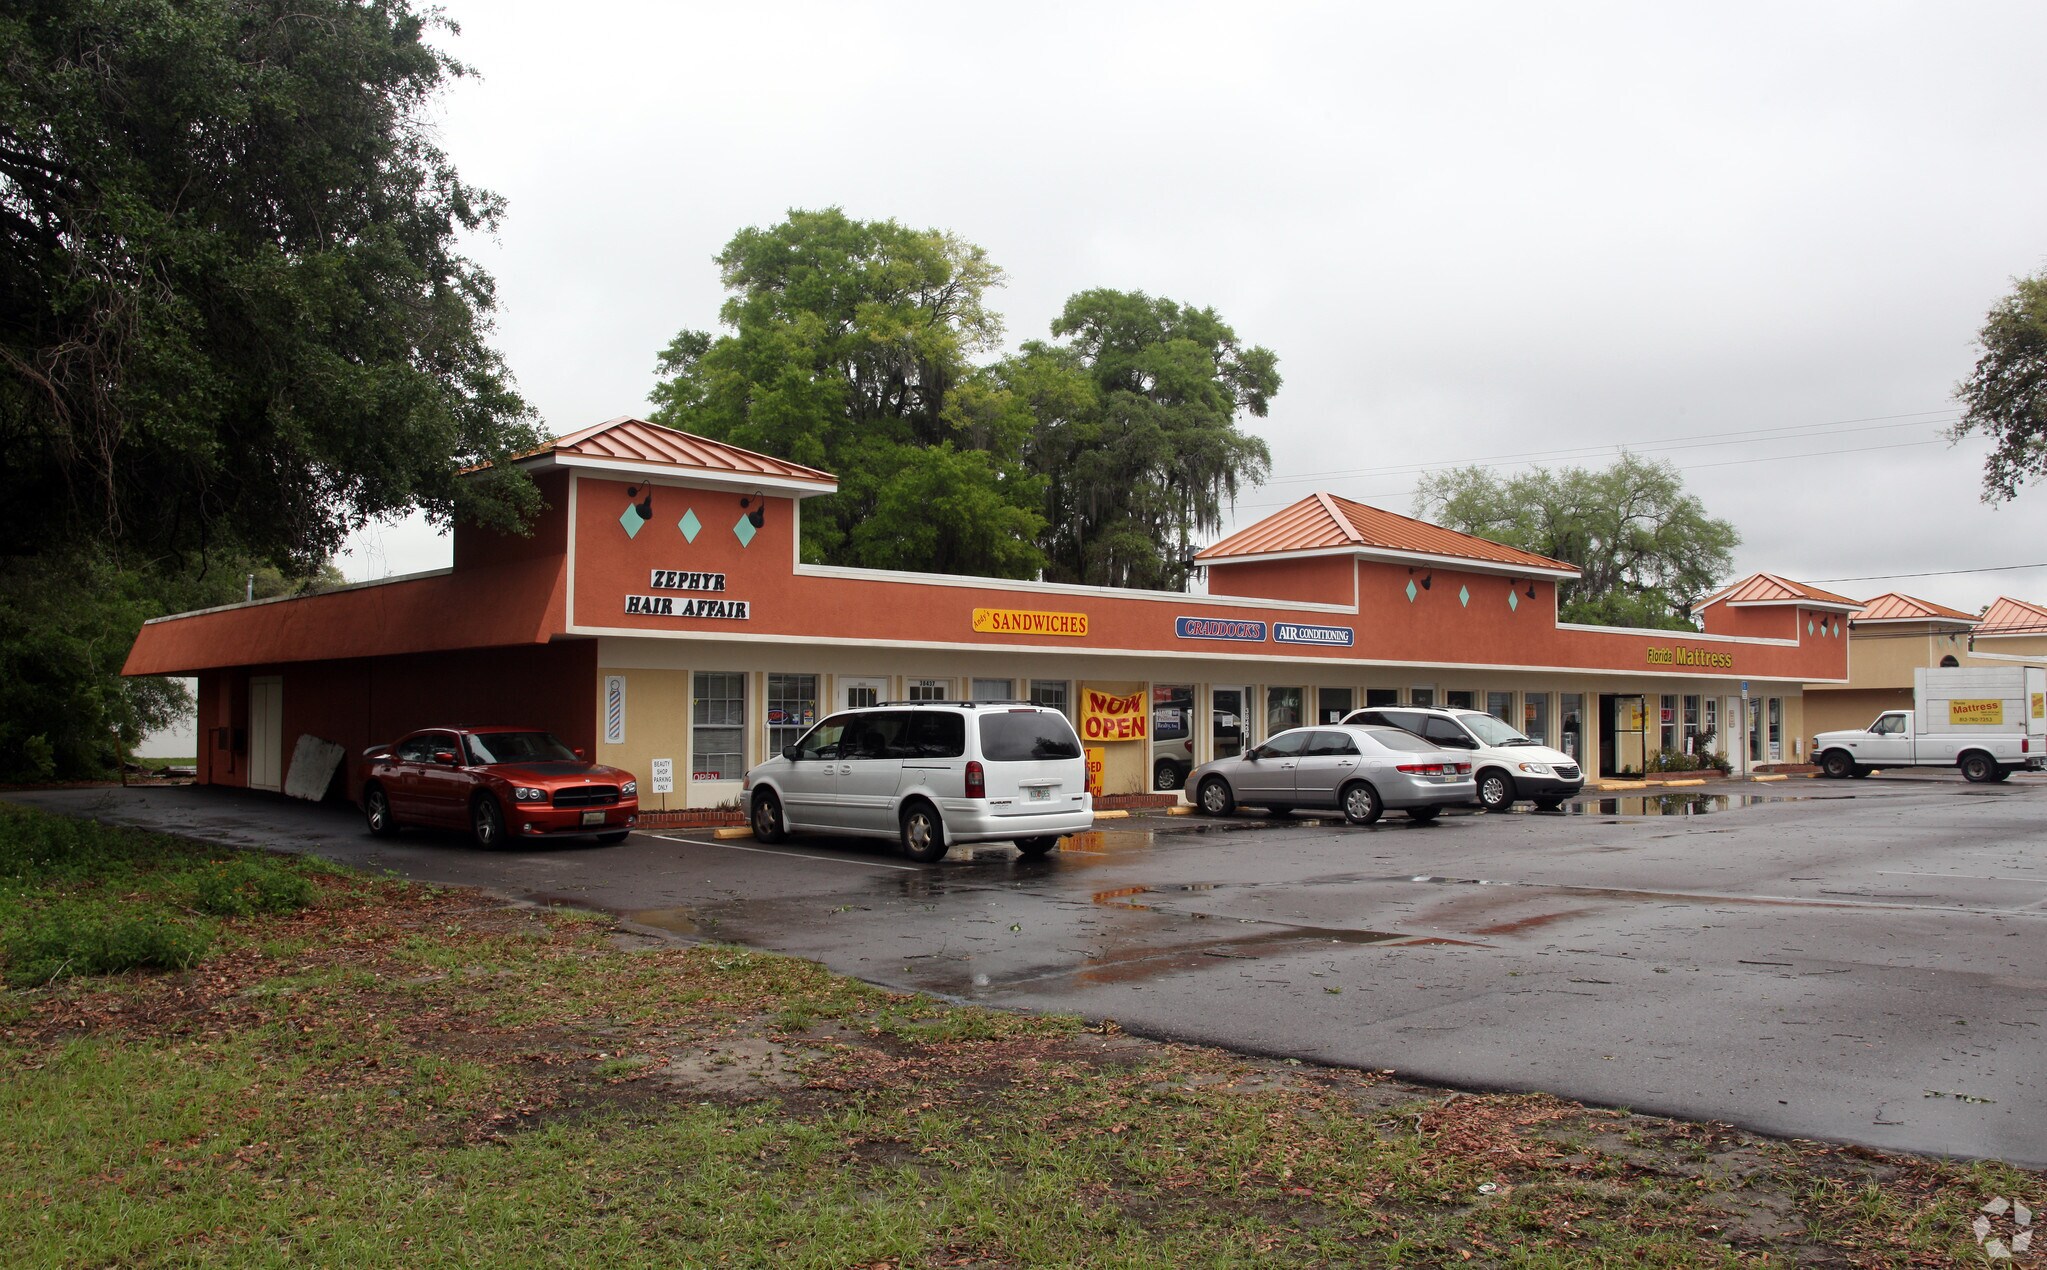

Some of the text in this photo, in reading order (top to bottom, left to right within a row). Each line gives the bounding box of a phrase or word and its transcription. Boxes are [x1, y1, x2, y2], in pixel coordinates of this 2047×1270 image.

[653, 570, 725, 590] ZEPHYR
[627, 596, 746, 618] HAIR AFFAIR
[974, 610, 1086, 633] Andy's SANDWICHES
[1185, 620, 1260, 638] CRADDOCKS
[1278, 626, 1349, 641] AIR CONDITIONING
[1647, 646, 1732, 668] Florida Mattress
[1090, 692, 1142, 714] NOW
[1953, 702, 1998, 714] Mattress
[1085, 716, 1145, 738] OPEN
